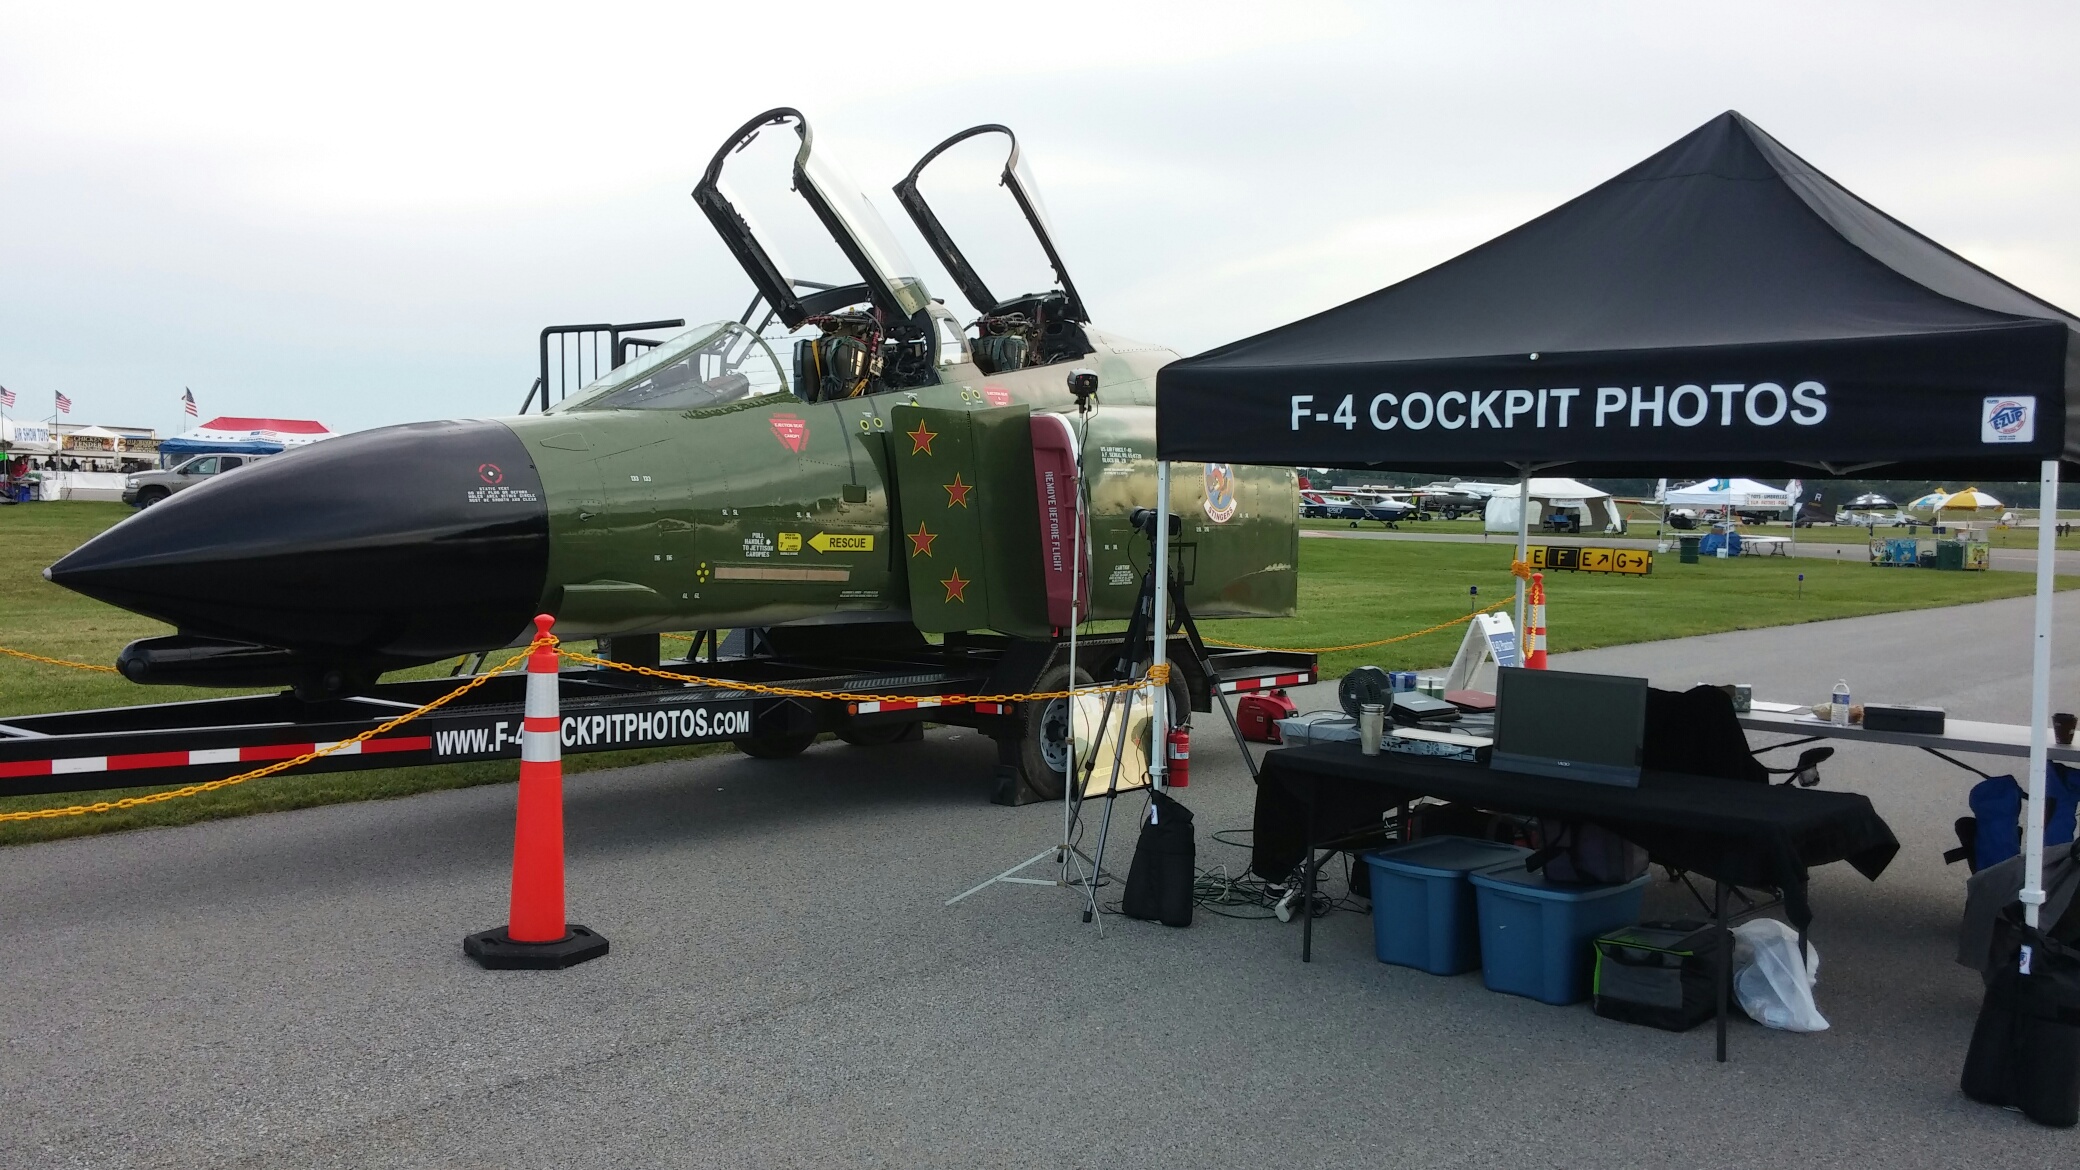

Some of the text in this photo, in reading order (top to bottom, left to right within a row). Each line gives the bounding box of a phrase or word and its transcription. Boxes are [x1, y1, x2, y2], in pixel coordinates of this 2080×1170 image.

[1290, 380, 1828, 431] F-4 COCKPIT PHOTOS
[23, 428, 36, 442] SHOW
[37, 428, 49, 442] TOYS
[1814, 493, 1822, 502] R
[1208, 506, 1233, 520] STINGERS
[1045, 471, 1062, 572] REMOVE BEFORE FLIGHT
[829, 538, 866, 548] RESCUE
[1534, 550, 1627, 568] E F E G
[436, 708, 750, 756] WWW.F-4CKPITPHOTOS.COM
